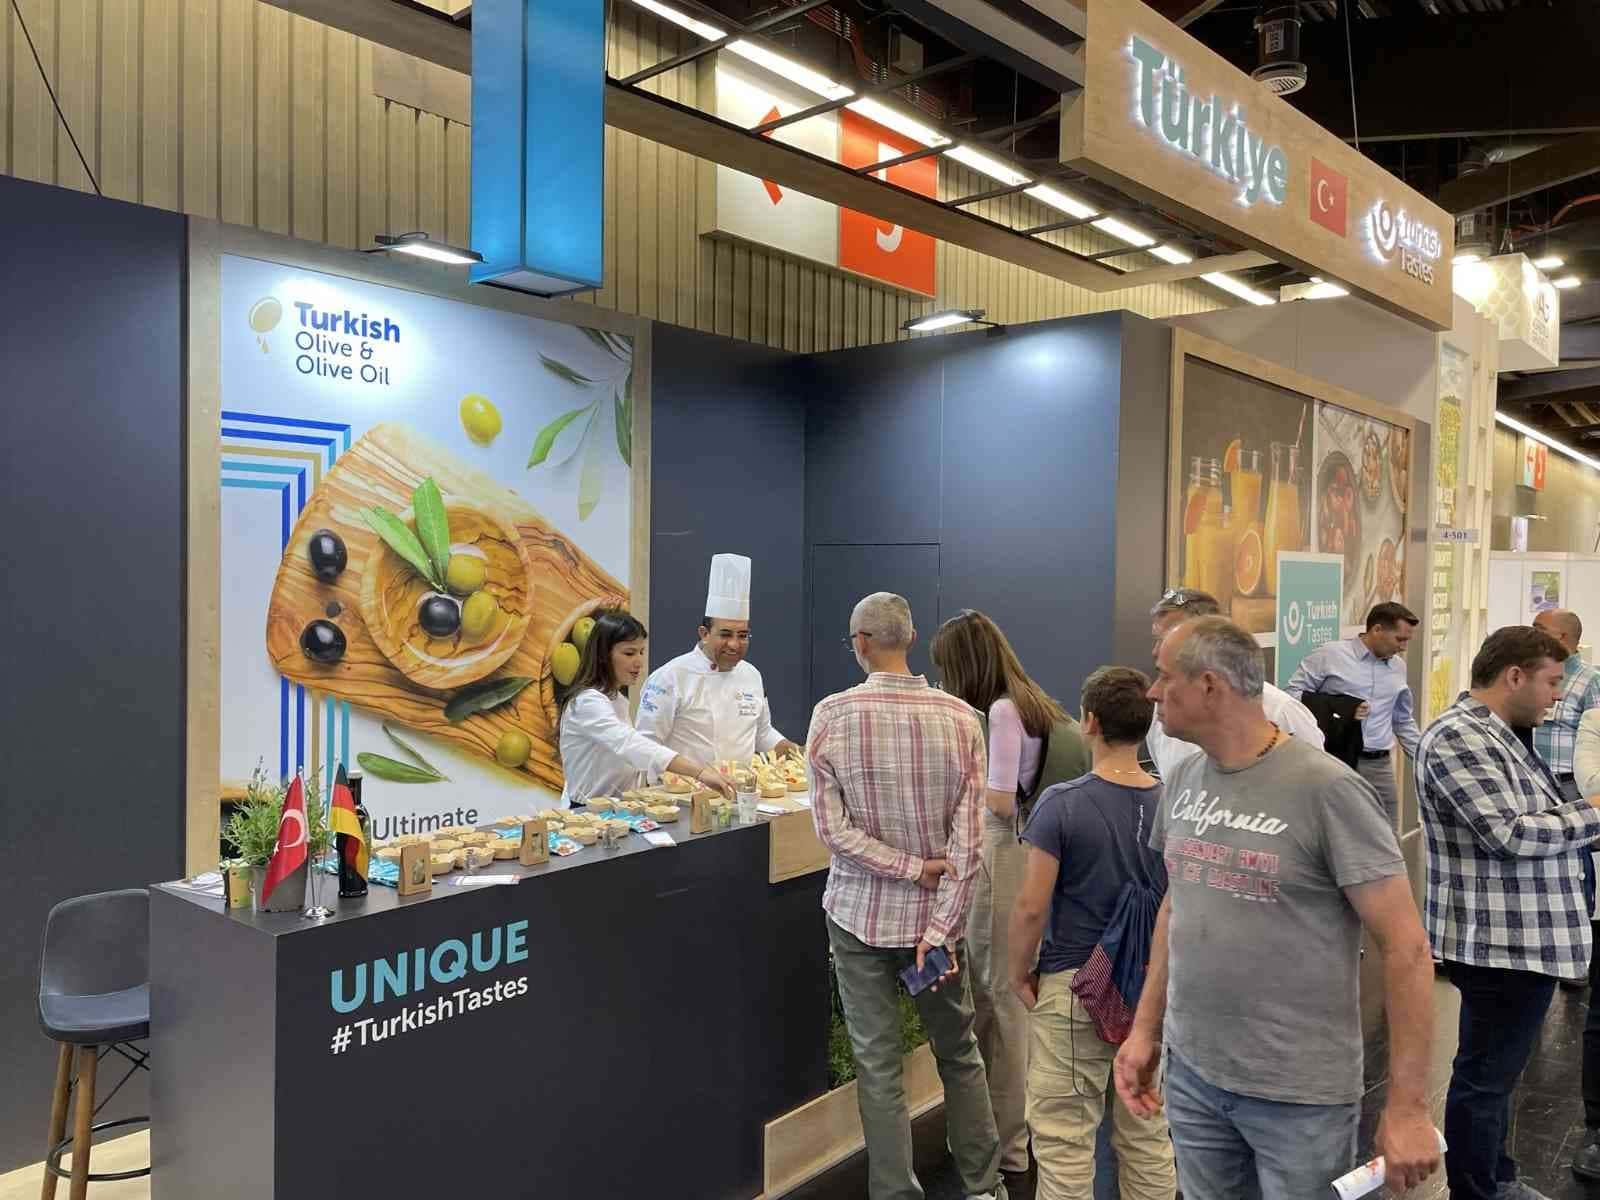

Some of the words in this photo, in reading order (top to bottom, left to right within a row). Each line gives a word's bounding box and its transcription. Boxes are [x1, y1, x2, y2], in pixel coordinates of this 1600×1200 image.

[1131, 34, 1288, 205] Türkiye
[1398, 246, 1433, 286] Tastes
[294, 301, 400, 343] Turkish
[295, 331, 352, 357] Olive
[360, 341, 373, 360] &
[296, 354, 353, 380] Olive
[360, 364, 390, 386] Oil
[1305, 599, 1337, 621] Turkish
[1305, 623, 1333, 645] Tastes
[372, 807, 478, 841] Ultimate
[1171, 789, 1288, 835] California
[330, 919, 529, 1014] UNIQUE
[331, 976, 529, 1055] #TurkishTastes
